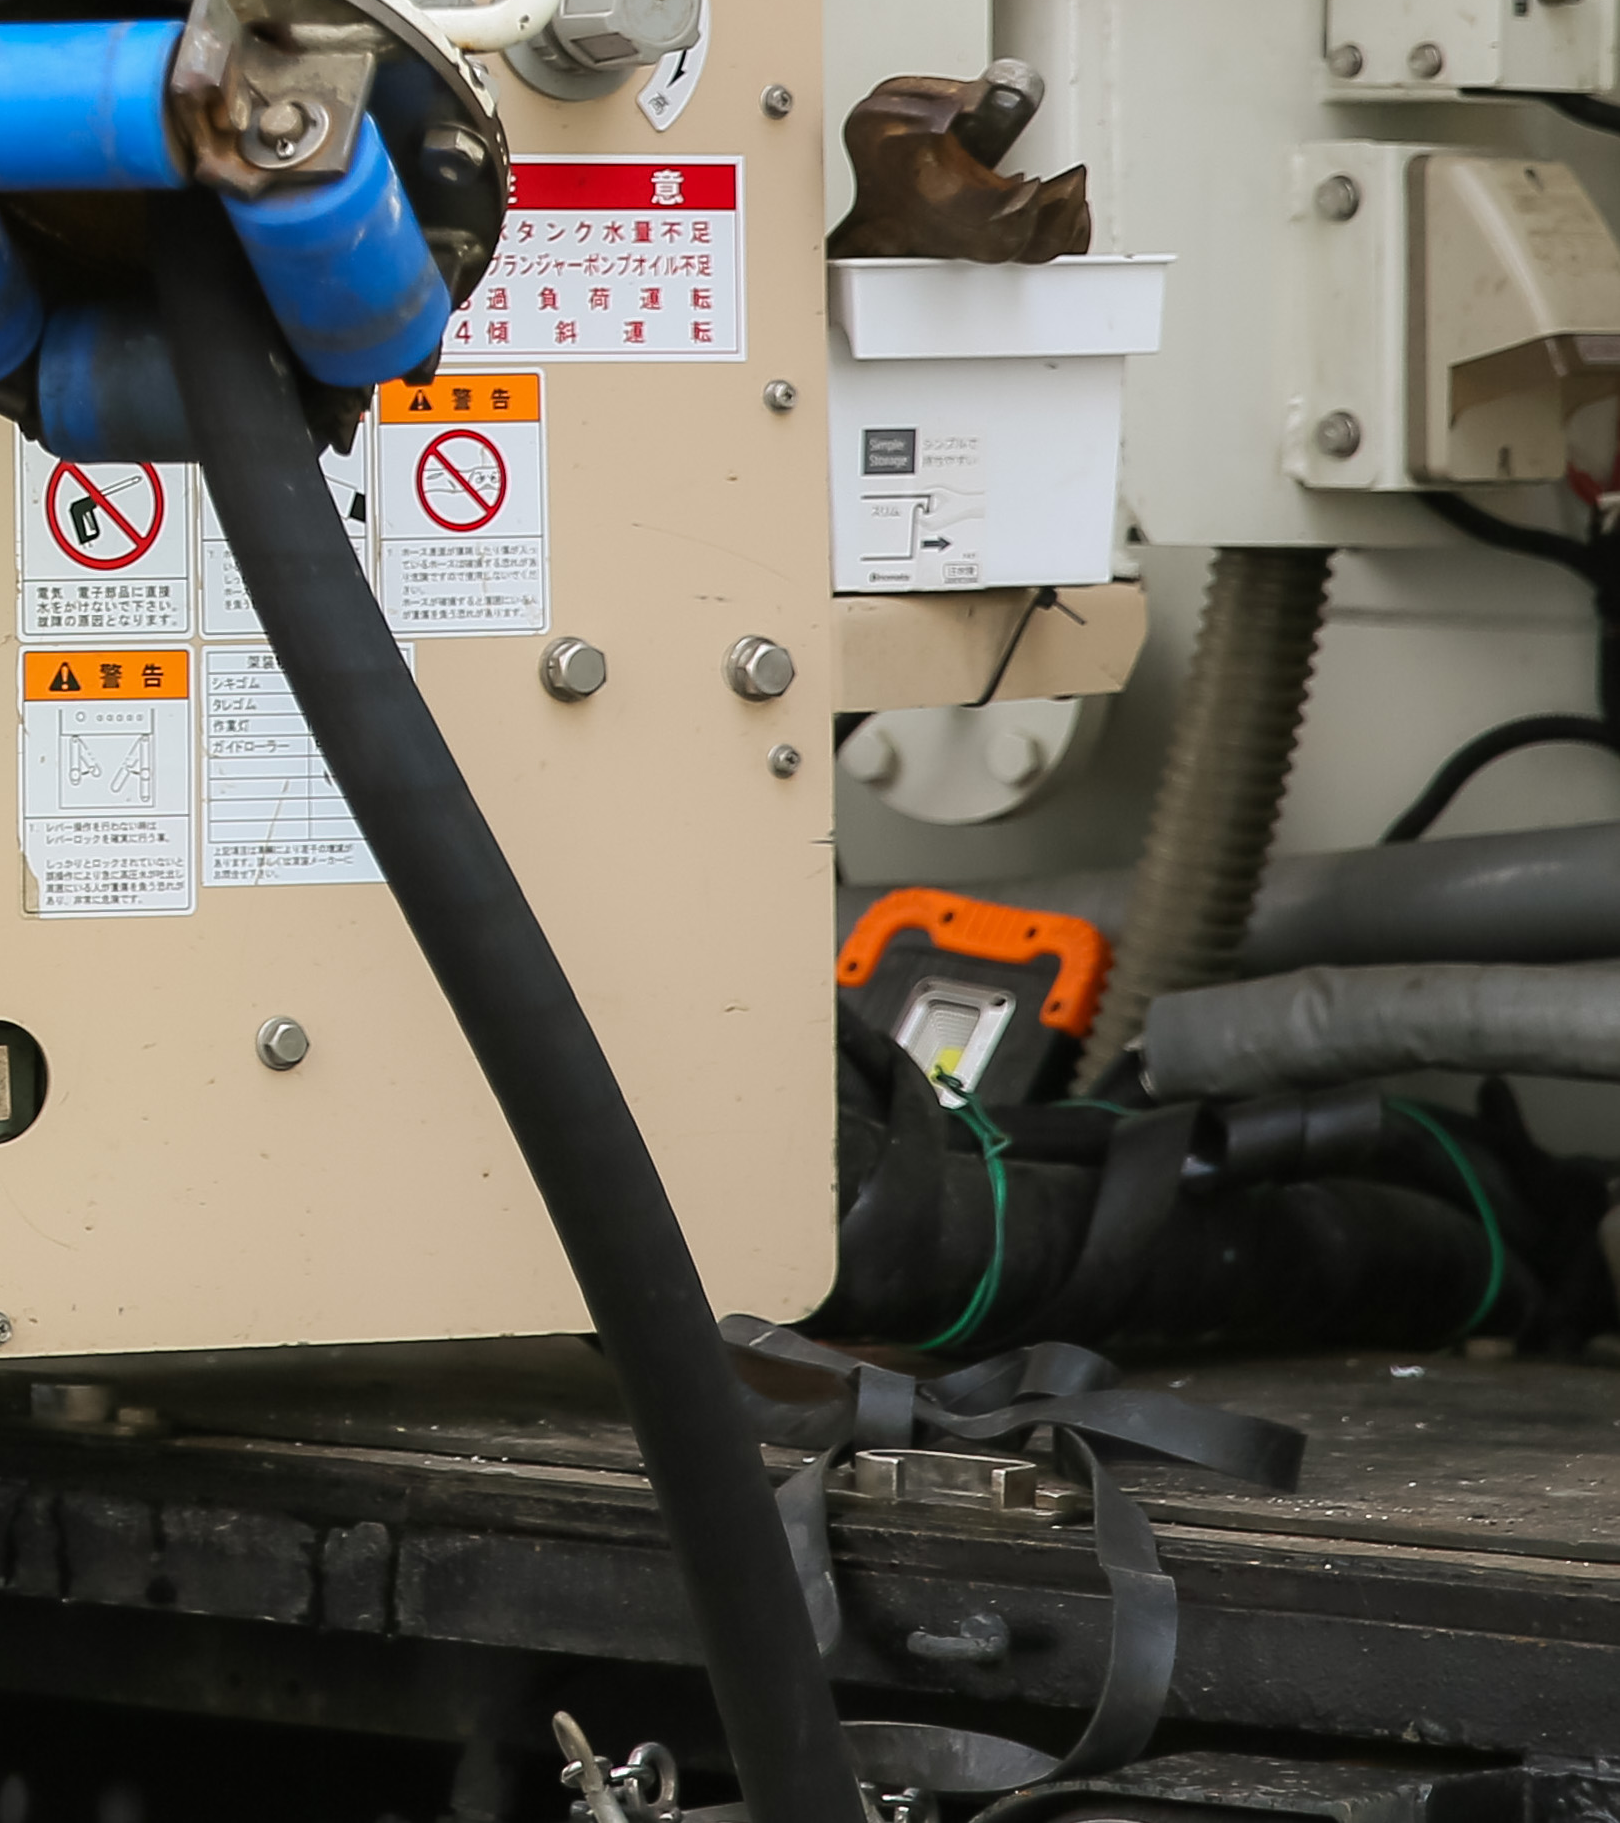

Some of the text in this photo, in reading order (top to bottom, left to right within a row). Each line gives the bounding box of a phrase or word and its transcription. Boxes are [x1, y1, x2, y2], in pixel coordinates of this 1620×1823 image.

[451, 387, 511, 411] 警告
[36, 585, 64, 600] 電気
[36, 599, 179, 614] 水をかけないで下さい。
[37, 614, 179, 628] 故障の原因となります。
[99, 663, 164, 689] 警告
[211, 677, 261, 691] シキゴム
[212, 697, 258, 711] タレゴム
[213, 719, 250, 733] 作業灯
[212, 740, 290, 754] ガイドローラー
